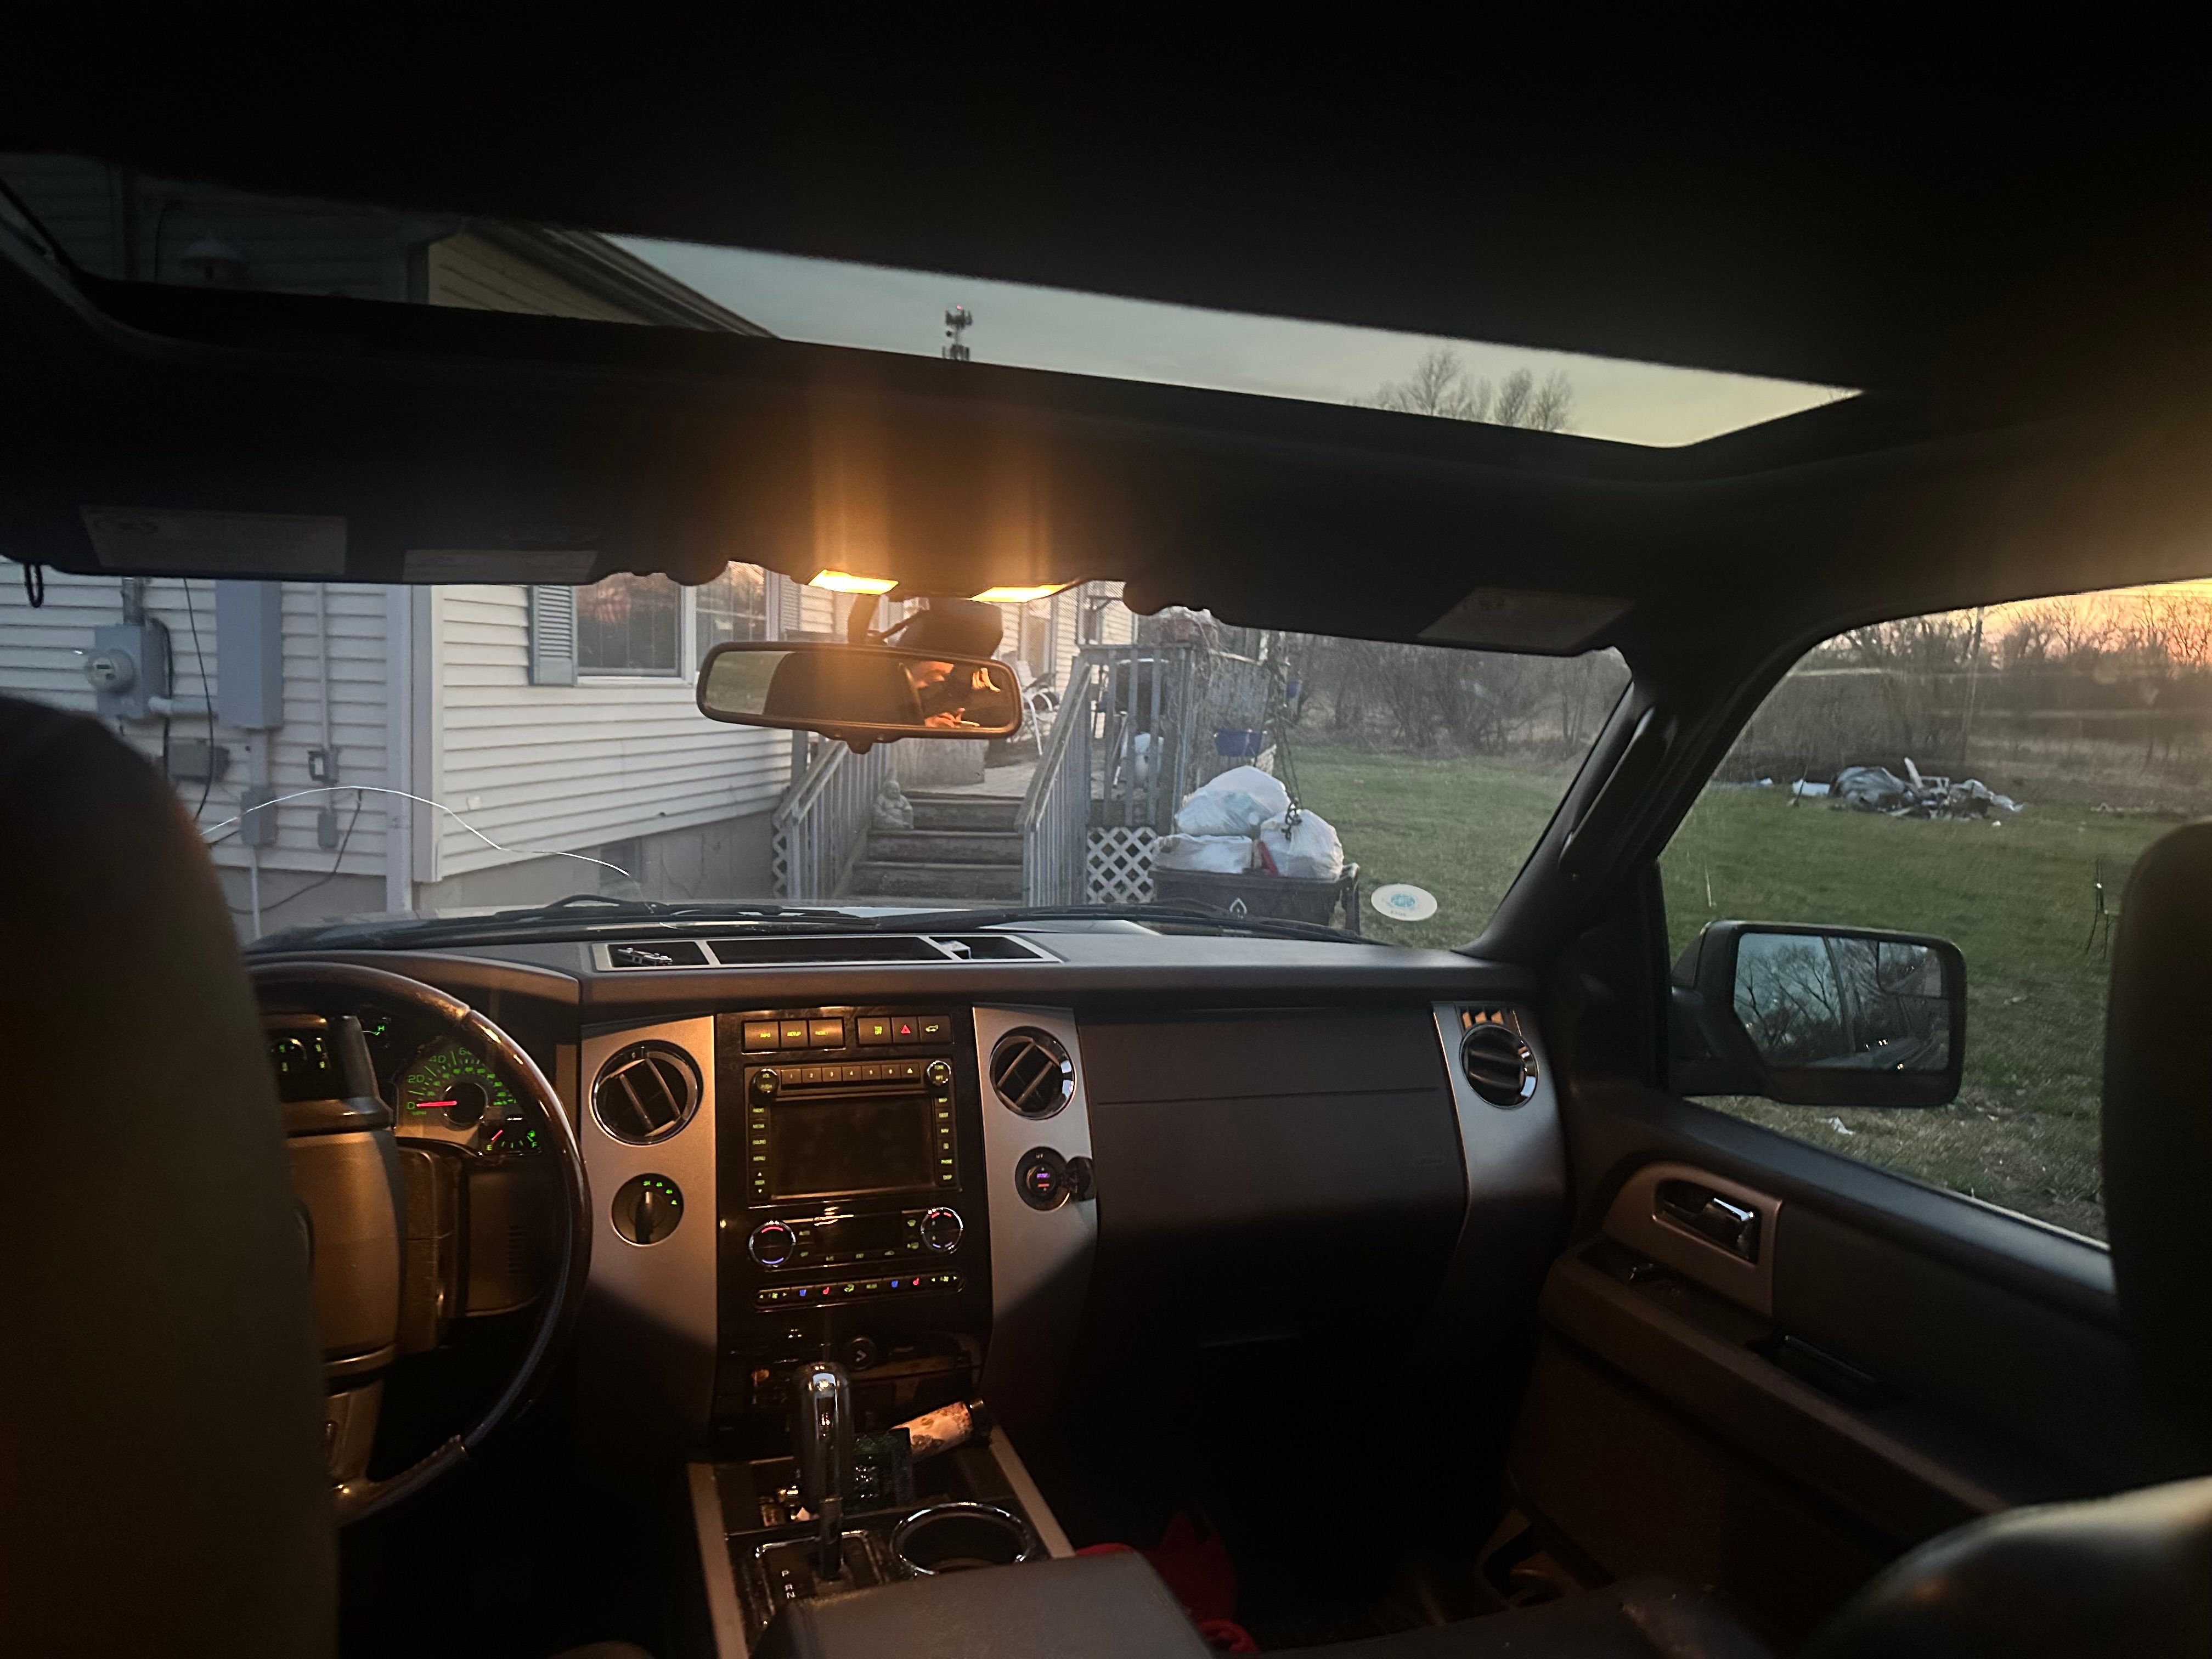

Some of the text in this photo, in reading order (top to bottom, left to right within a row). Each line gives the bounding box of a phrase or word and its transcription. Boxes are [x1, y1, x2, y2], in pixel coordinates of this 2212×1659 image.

[429, 1055, 447, 1063] 40
[408, 1074, 425, 1084] 20
[407, 1101, 415, 1110] 0
